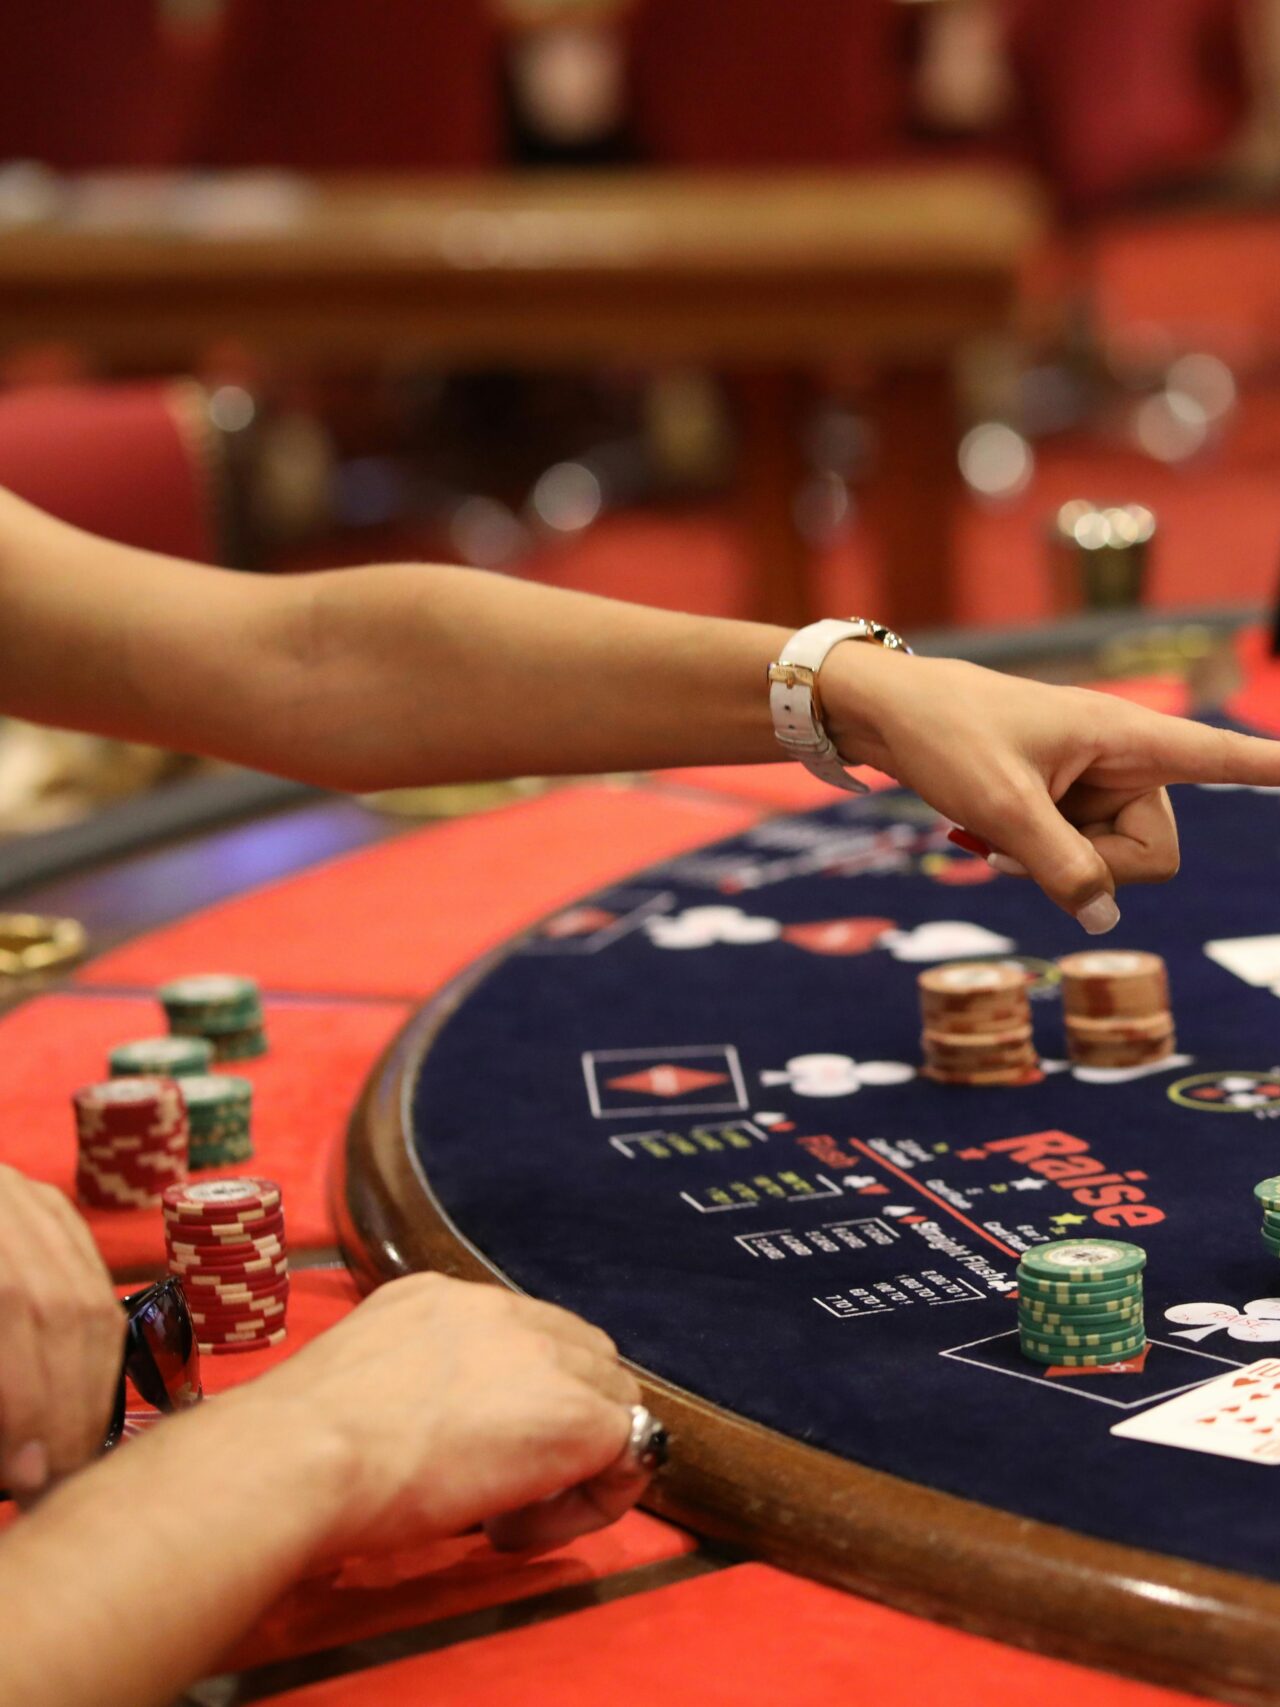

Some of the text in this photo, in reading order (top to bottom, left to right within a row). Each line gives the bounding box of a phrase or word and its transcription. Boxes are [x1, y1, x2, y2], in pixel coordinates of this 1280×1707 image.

[984, 1130, 1167, 1228] Raise
[911, 1221, 1007, 1283] Straight Flush
[914, 1287, 935, 1297] TO
[943, 1283, 963, 1293] TO
[859, 1295, 880, 1304] TO
[887, 1291, 908, 1300] TO
[832, 1299, 853, 1308] TO
